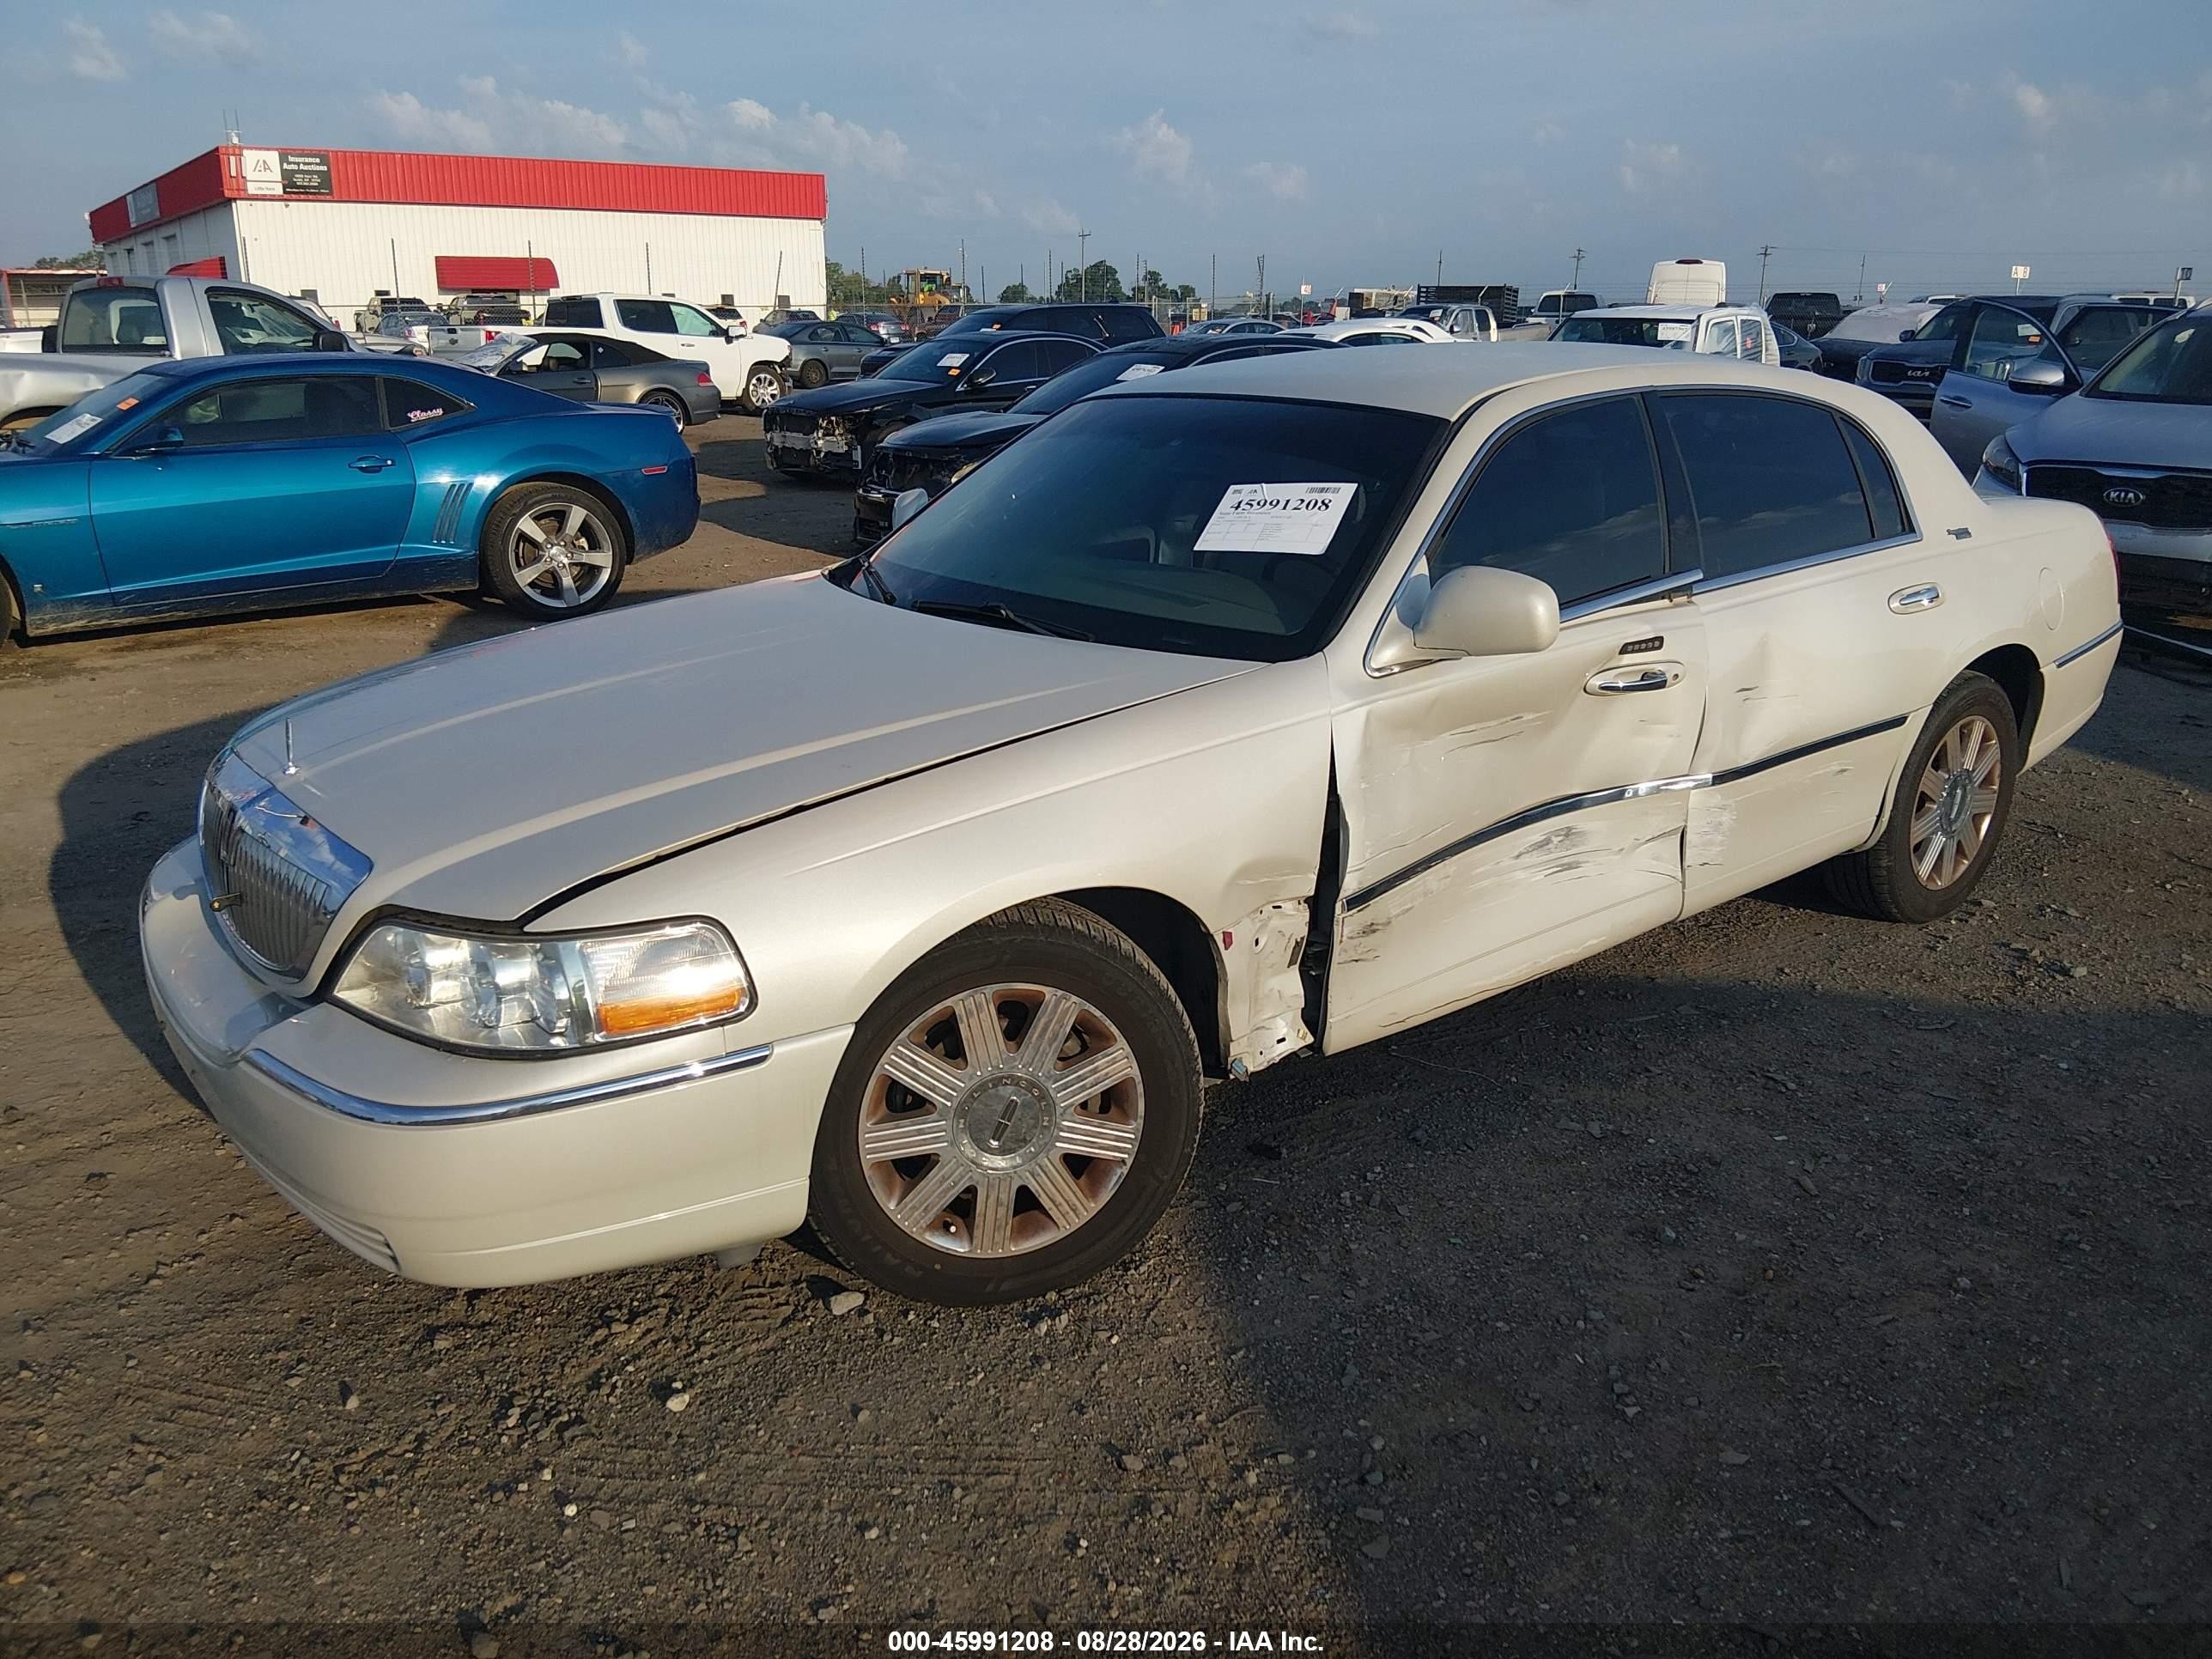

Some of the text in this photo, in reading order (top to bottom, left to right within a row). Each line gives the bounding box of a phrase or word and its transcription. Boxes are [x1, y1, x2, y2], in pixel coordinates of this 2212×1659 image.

[1229, 497, 1333, 512] 45991208
[2109, 491, 2136, 503] KIA
[972, 1078, 1049, 1126] LINCOLN
